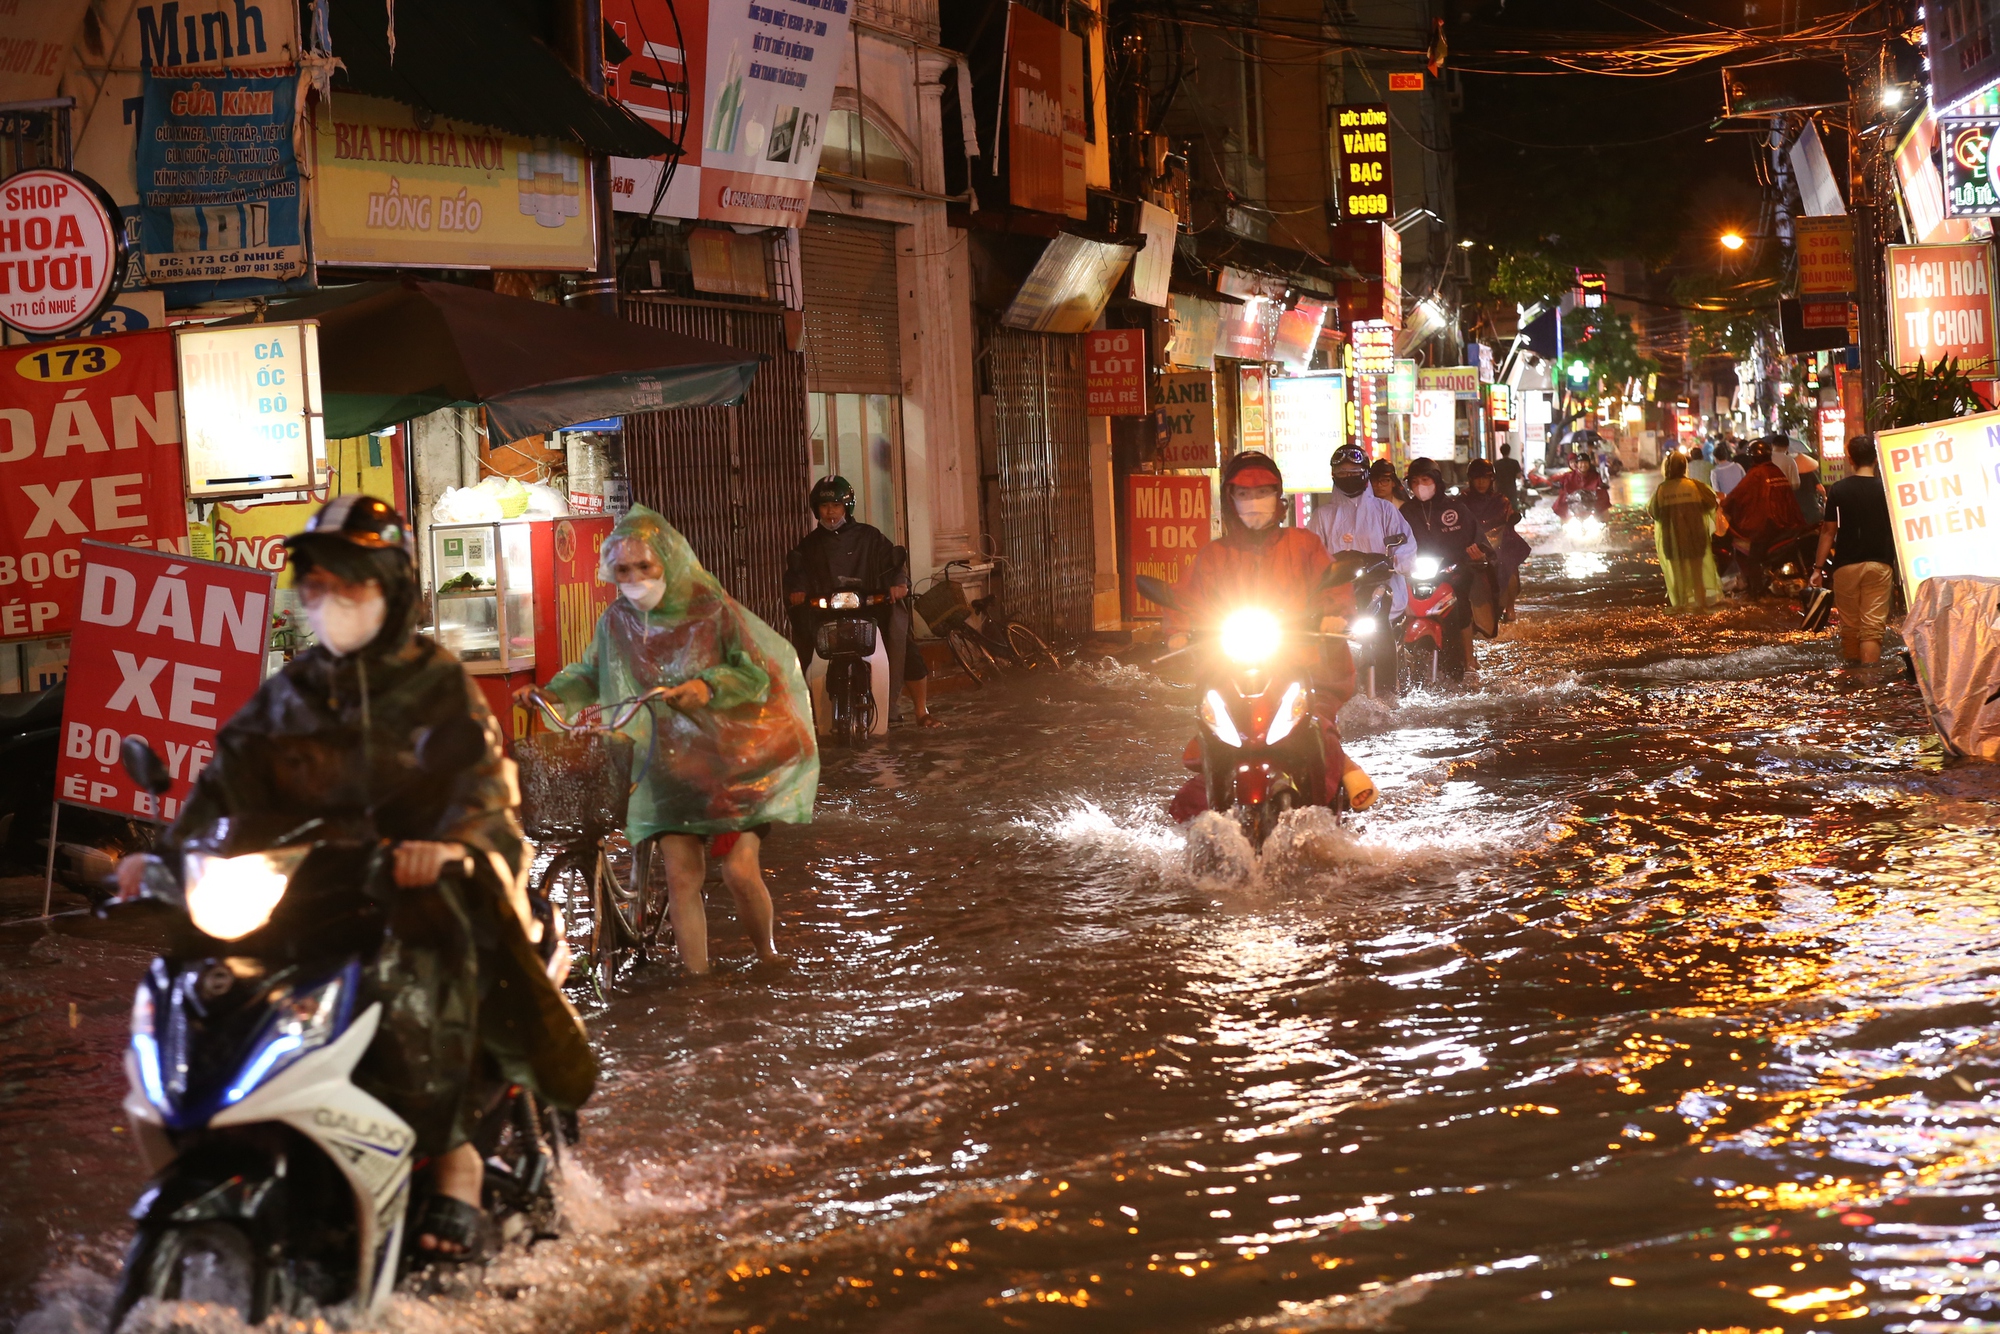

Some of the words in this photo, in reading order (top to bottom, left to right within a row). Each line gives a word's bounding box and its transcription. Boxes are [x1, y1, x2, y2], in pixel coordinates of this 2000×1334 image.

[137, 0, 267, 67] Minh
[171, 82, 217, 116] CỬA
[221, 87, 274, 116] KÍNH
[333, 122, 376, 161] BIA
[377, 126, 425, 164] HƠI
[427, 123, 463, 169] HÀ
[463, 129, 505, 180] NỘI
[1343, 130, 1387, 154] VÀNG
[154, 168, 178, 186] KÍNH
[1350, 162, 1382, 186] BẠC
[5, 184, 68, 211] SHOP
[366, 175, 432, 231] HỒNG
[438, 186, 483, 233] BÉO
[1348, 194, 1388, 215] 9999
[0, 215, 85, 251] HOA
[0, 254, 93, 294] TƯƠI
[159, 257, 184, 268] ĐC:
[188, 255, 215, 265] 173
[243, 248, 286, 262] NHUẾ
[166, 268, 183, 278] 085
[185, 267, 202, 276] 445
[234, 264, 253, 274] 097
[253, 263, 270, 273] 981
[1895, 255, 1946, 299] BÁCH
[1949, 252, 1988, 297] HOÁ
[10, 303, 28, 316] 171
[31, 296, 46, 315] CỔ
[48, 294, 77, 314] NHUẾ
[1904, 307, 1930, 355] TỰ
[1932, 309, 1984, 353] CHỌN
[33, 347, 106, 379] 173
[254, 338, 284, 360] CÁ
[1090, 356, 1136, 374] LÓT
[256, 364, 286, 387] ỐC
[1088, 378, 1113, 387] NAM
[1155, 379, 1208, 404] BÁNH
[1435, 372, 1476, 391] NÓNG
[258, 392, 288, 414] BÒ
[1089, 389, 1115, 403] GIÁ
[0, 388, 181, 464] DÁN
[1181, 441, 1209, 461] GÒN
[1890, 430, 1954, 473] PHỞ
[1136, 481, 1174, 518] MÍA
[1180, 481, 1207, 518] ĐÁ
[1897, 473, 1963, 507] BÚN
[20, 473, 148, 540] XE
[1904, 501, 1986, 542] MIẾN
[1145, 525, 1198, 548] 10K
[0, 549, 81, 589] BỌC
[2, 598, 60, 635] ÉP
[80, 562, 267, 655] DÁN
[105, 649, 222, 730] XE
[66, 721, 149, 773] BỌ
[63, 774, 118, 804] ÉP
